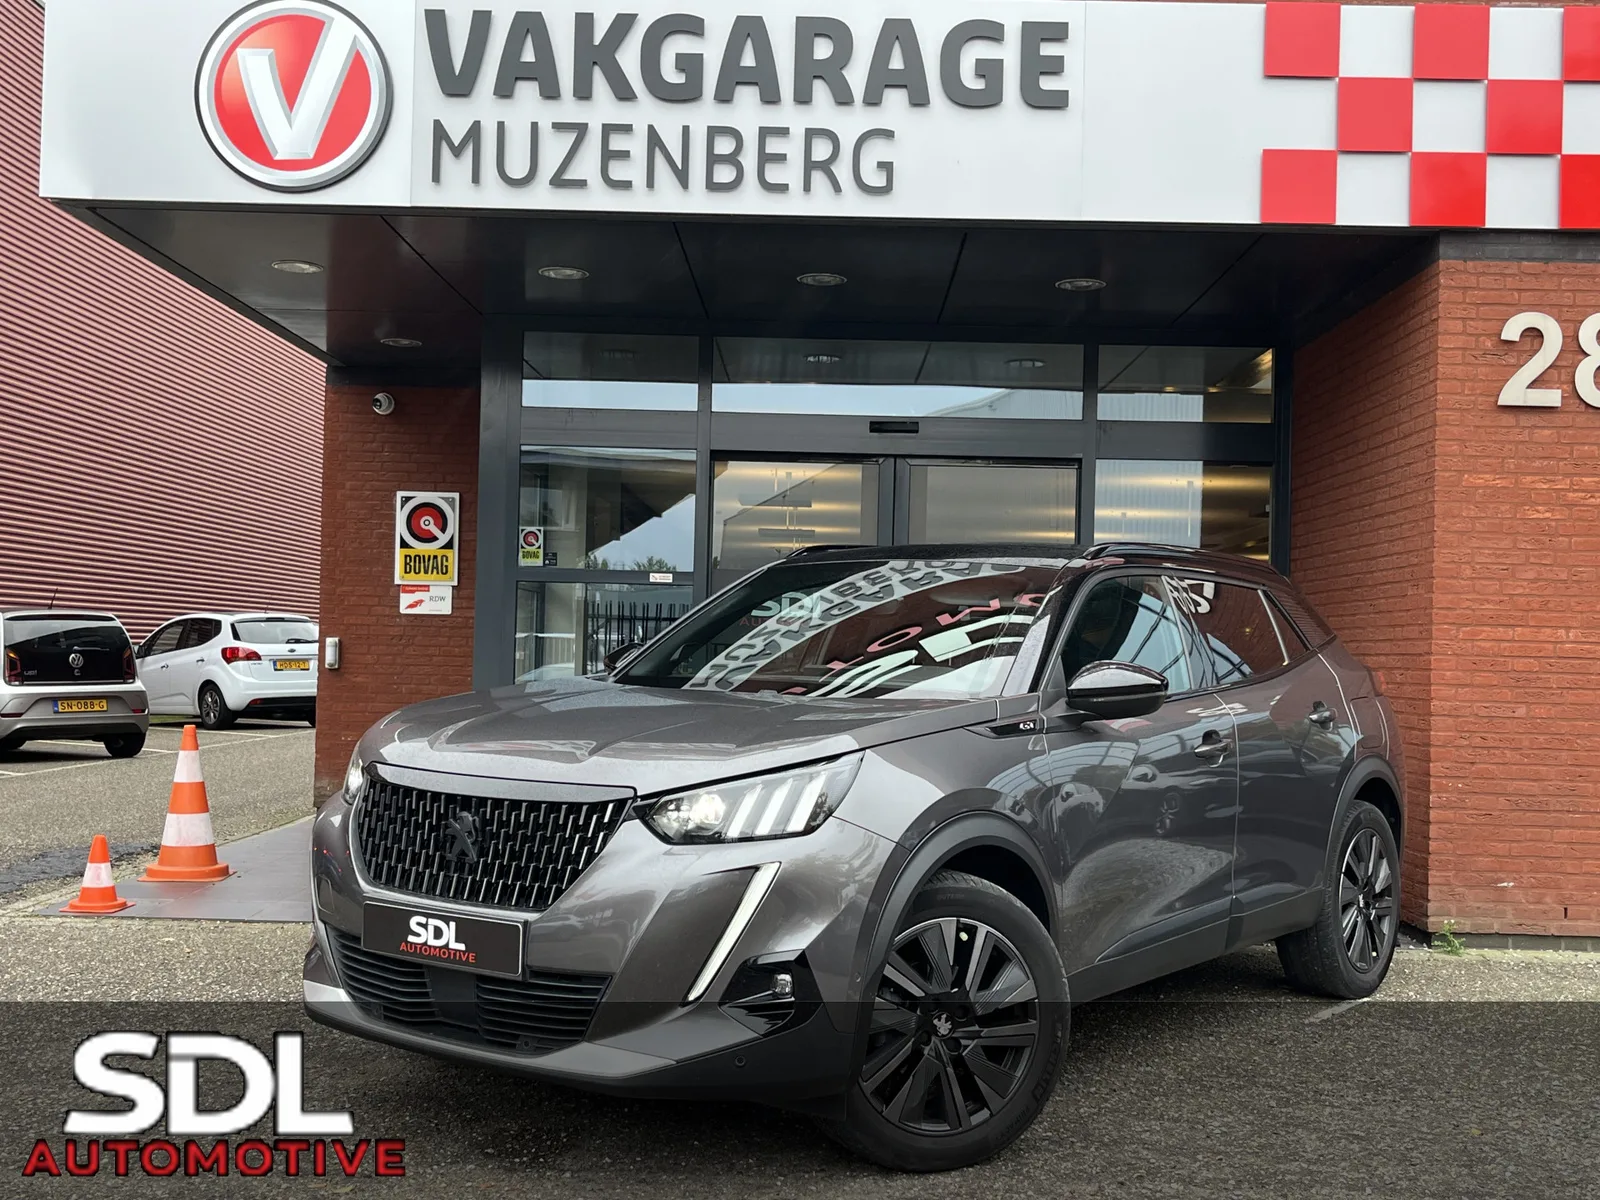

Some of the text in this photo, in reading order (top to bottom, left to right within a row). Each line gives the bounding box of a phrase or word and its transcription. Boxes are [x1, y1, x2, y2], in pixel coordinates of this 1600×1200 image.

[424, 9, 1070, 109] VAKGARAGE
[431, 119, 896, 196] MUZENBERG
[404, 554, 449, 575] BOVAG
[522, 550, 540, 560] BOVAG
[60, 700, 105, 711] SN-088-G
[407, 915, 466, 951] SDL
[399, 941, 477, 963] AUTOMOTIVE
